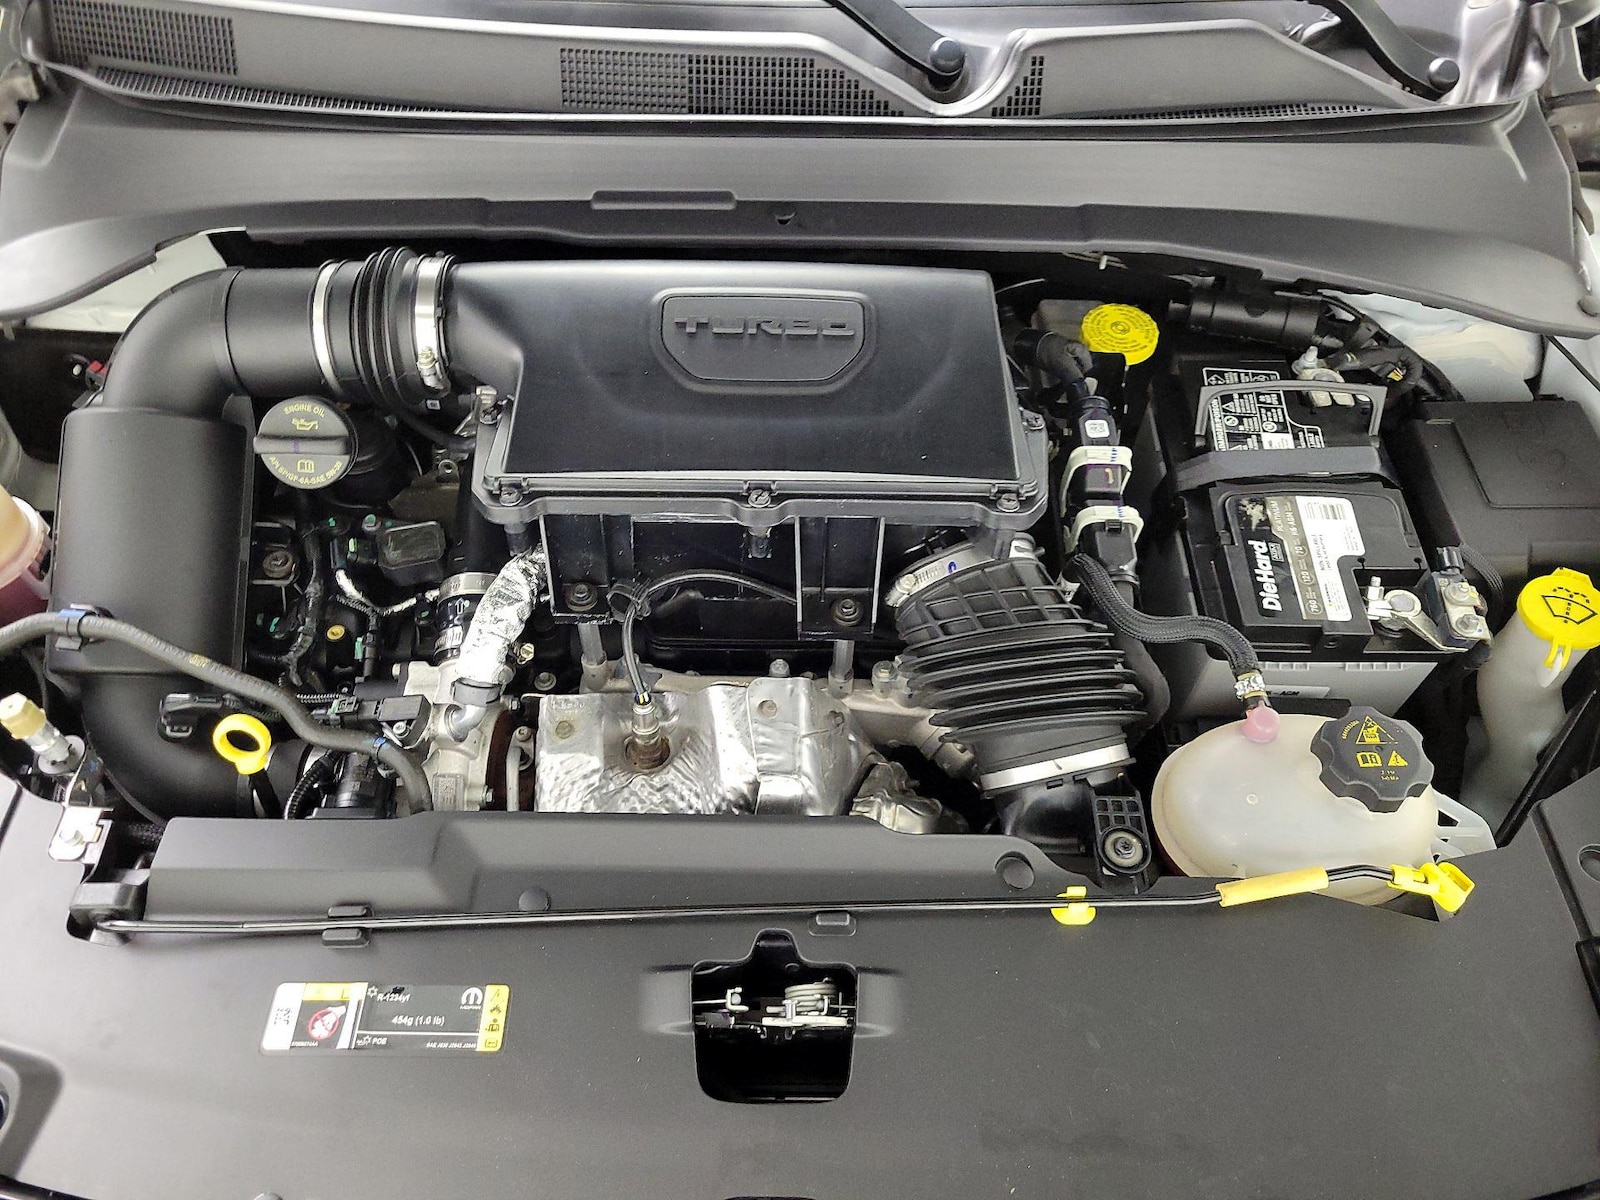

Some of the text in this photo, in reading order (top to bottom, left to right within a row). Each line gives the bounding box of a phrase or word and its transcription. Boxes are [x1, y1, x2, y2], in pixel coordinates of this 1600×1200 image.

[675, 315, 855, 336] TURBO
[284, 403, 325, 418] ENGINE OIL
[1270, 500, 1284, 532] PLATINUM
[1247, 540, 1283, 611] DieHard
[1301, 571, 1312, 584] 120
[1308, 599, 1320, 612] 760
[392, 1015, 445, 1027] 454g (1.0 lb)
[371, 1037, 388, 1046] POE
